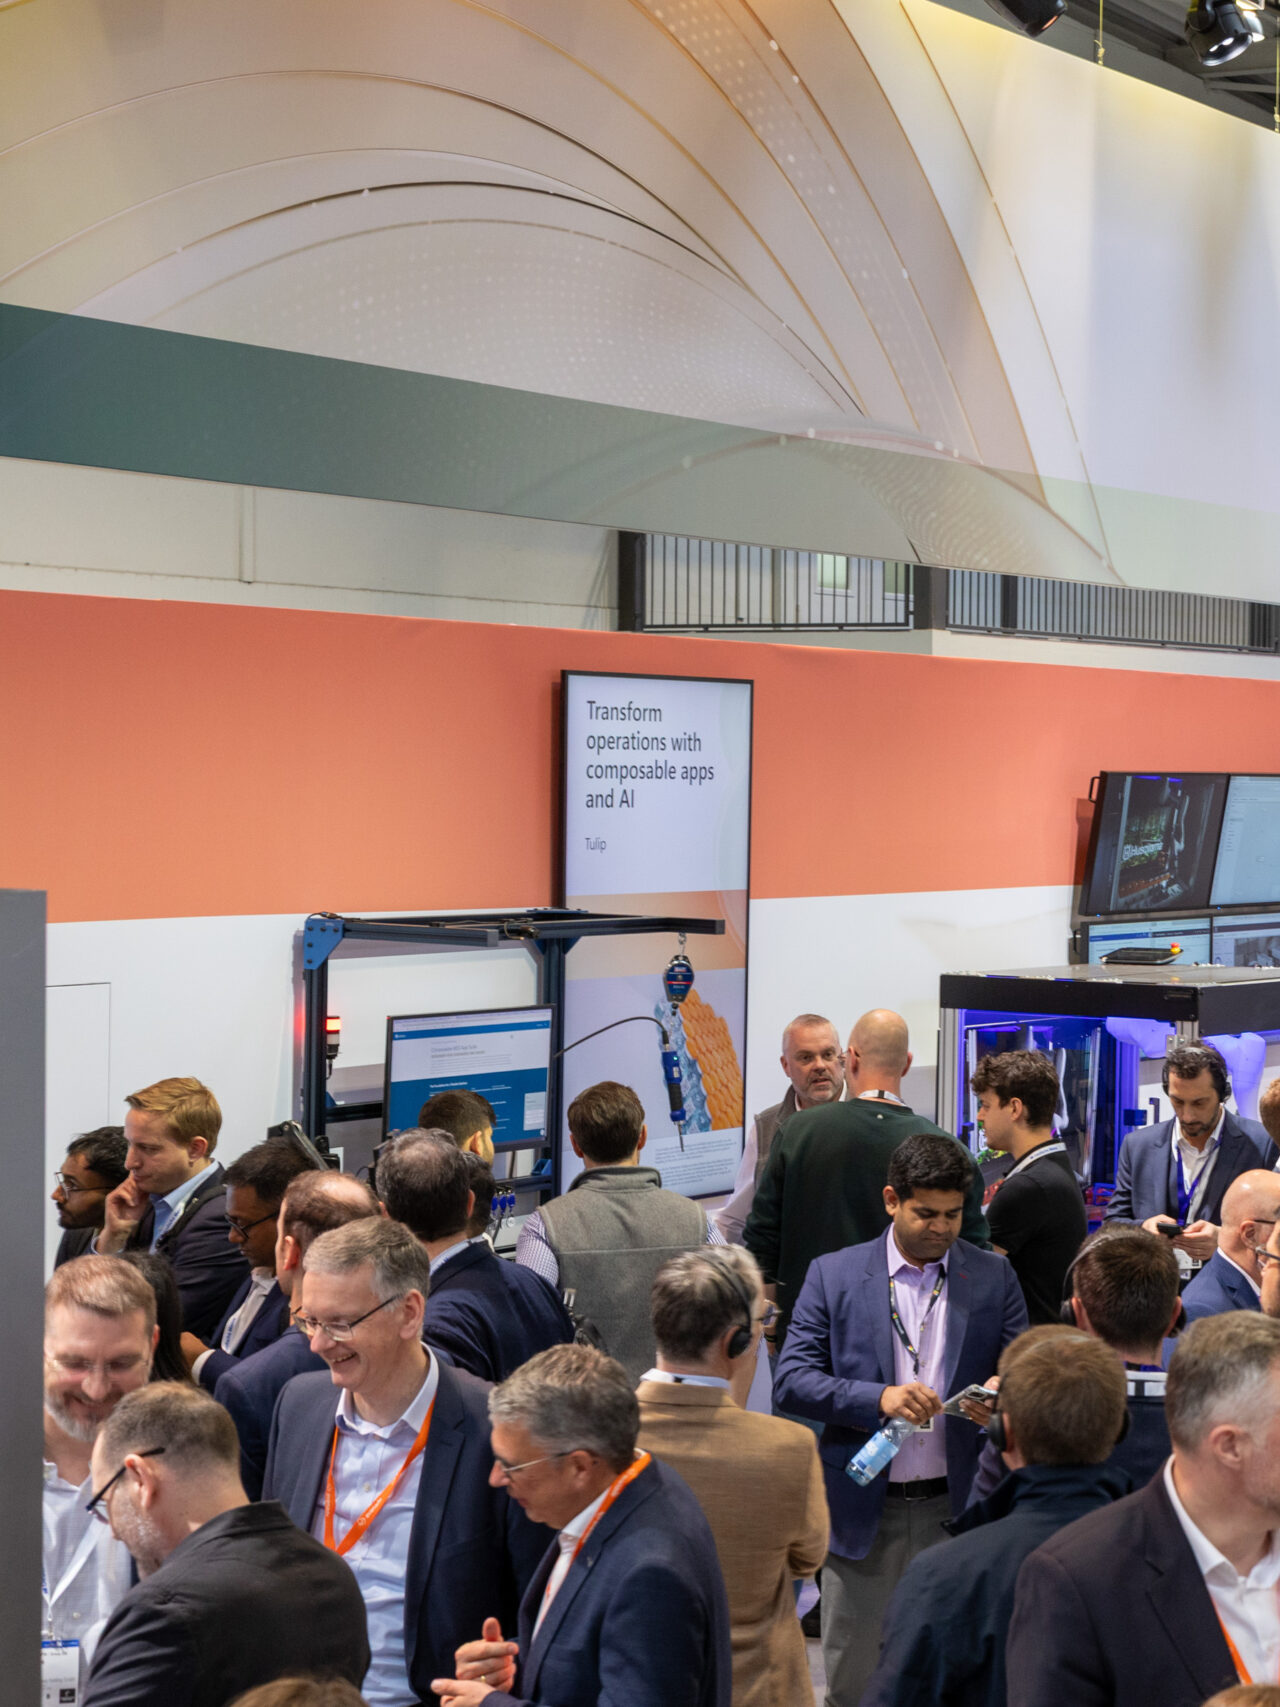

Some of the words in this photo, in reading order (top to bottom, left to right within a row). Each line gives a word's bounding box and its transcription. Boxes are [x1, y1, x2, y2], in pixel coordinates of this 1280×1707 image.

[586, 700, 663, 722] Transform
[586, 731, 666, 755] operations
[671, 732, 702, 752] with
[586, 760, 676, 785] composable
[681, 765, 715, 786] apps
[585, 788, 614, 808] and
[619, 789, 635, 808] AI
[585, 837, 607, 853] Tulip
